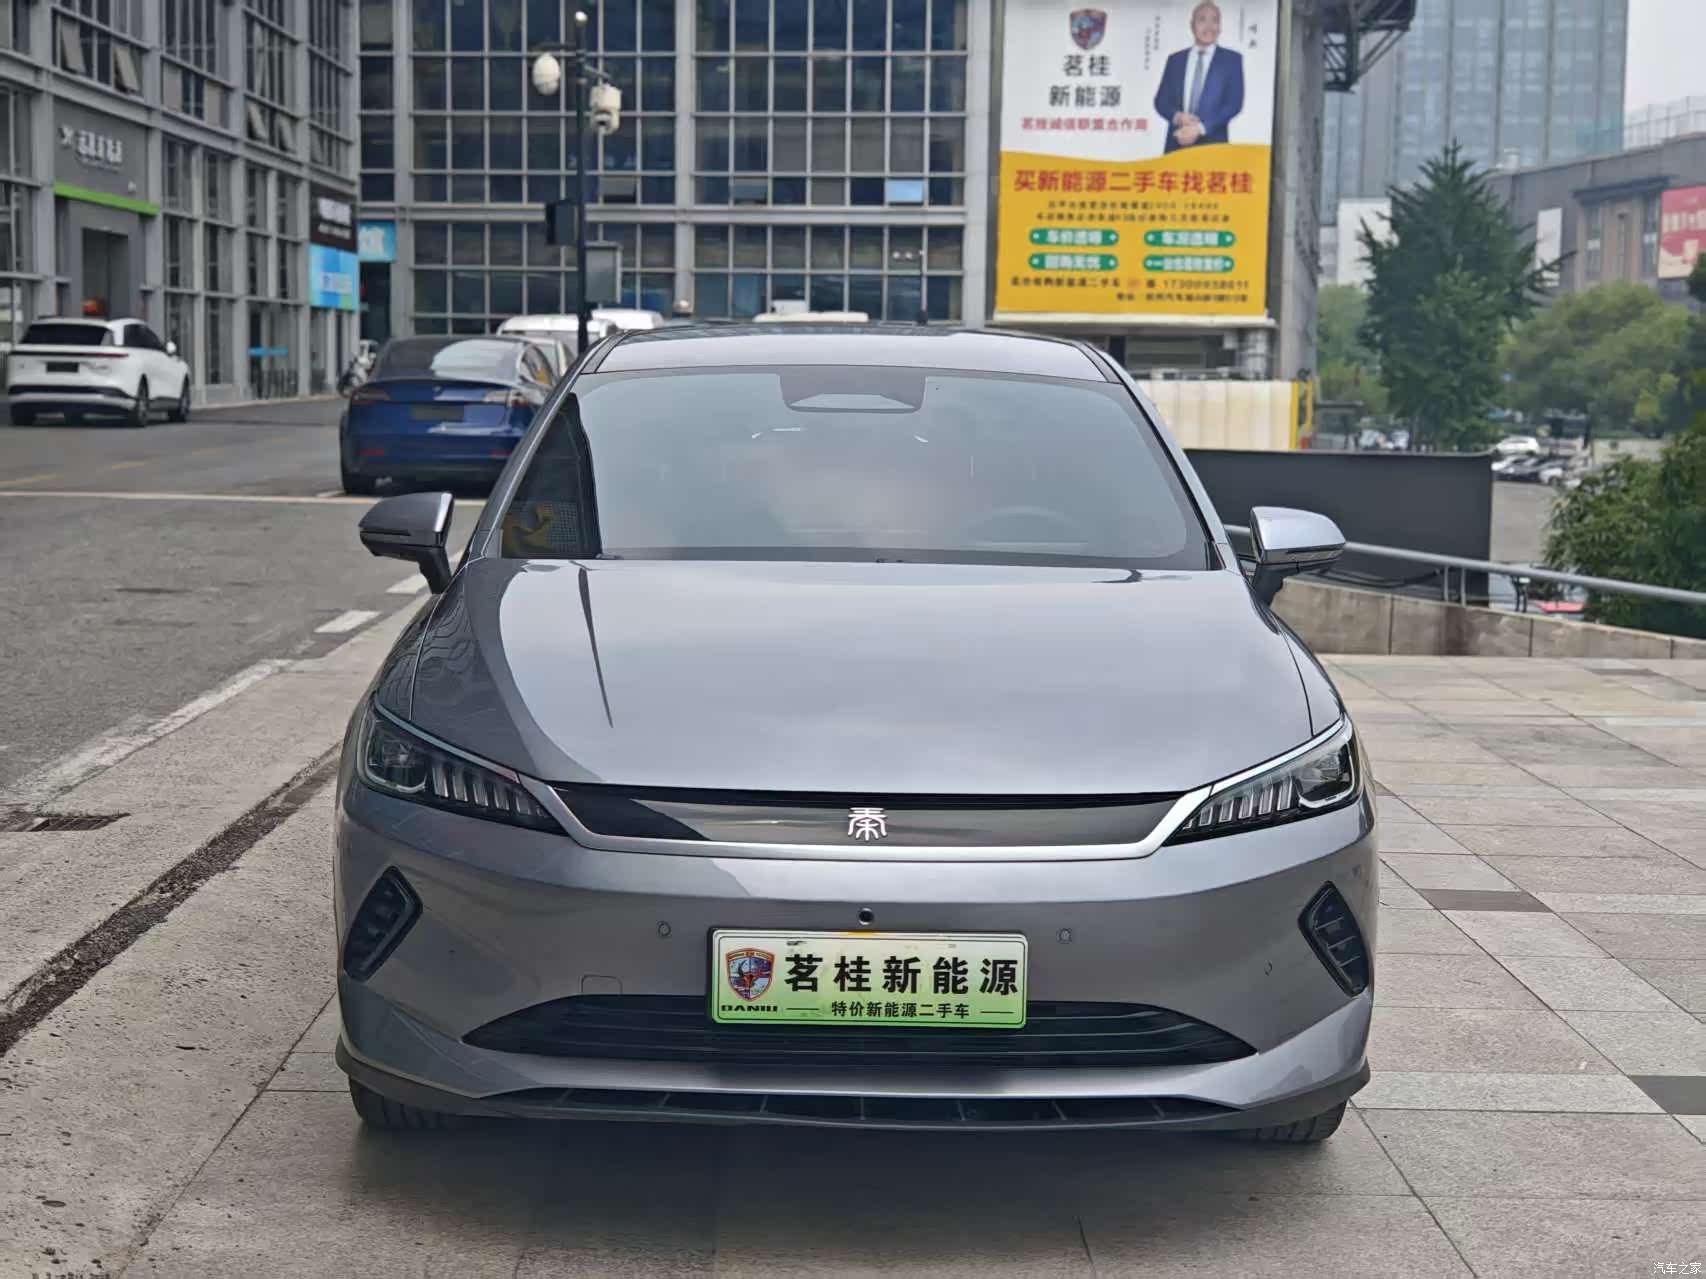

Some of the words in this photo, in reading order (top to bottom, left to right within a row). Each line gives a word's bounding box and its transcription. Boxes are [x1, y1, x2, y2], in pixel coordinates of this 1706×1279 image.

[1063, 54, 1110, 77] 茗桂
[1049, 85, 1121, 108] 新能源
[1014, 170, 1254, 194] 买新能源二手车找茗桂
[847, 807, 887, 841] 秦
[784, 954, 1019, 996] 茗桂新能源
[831, 1001, 970, 1019] 特价新能源二手车
